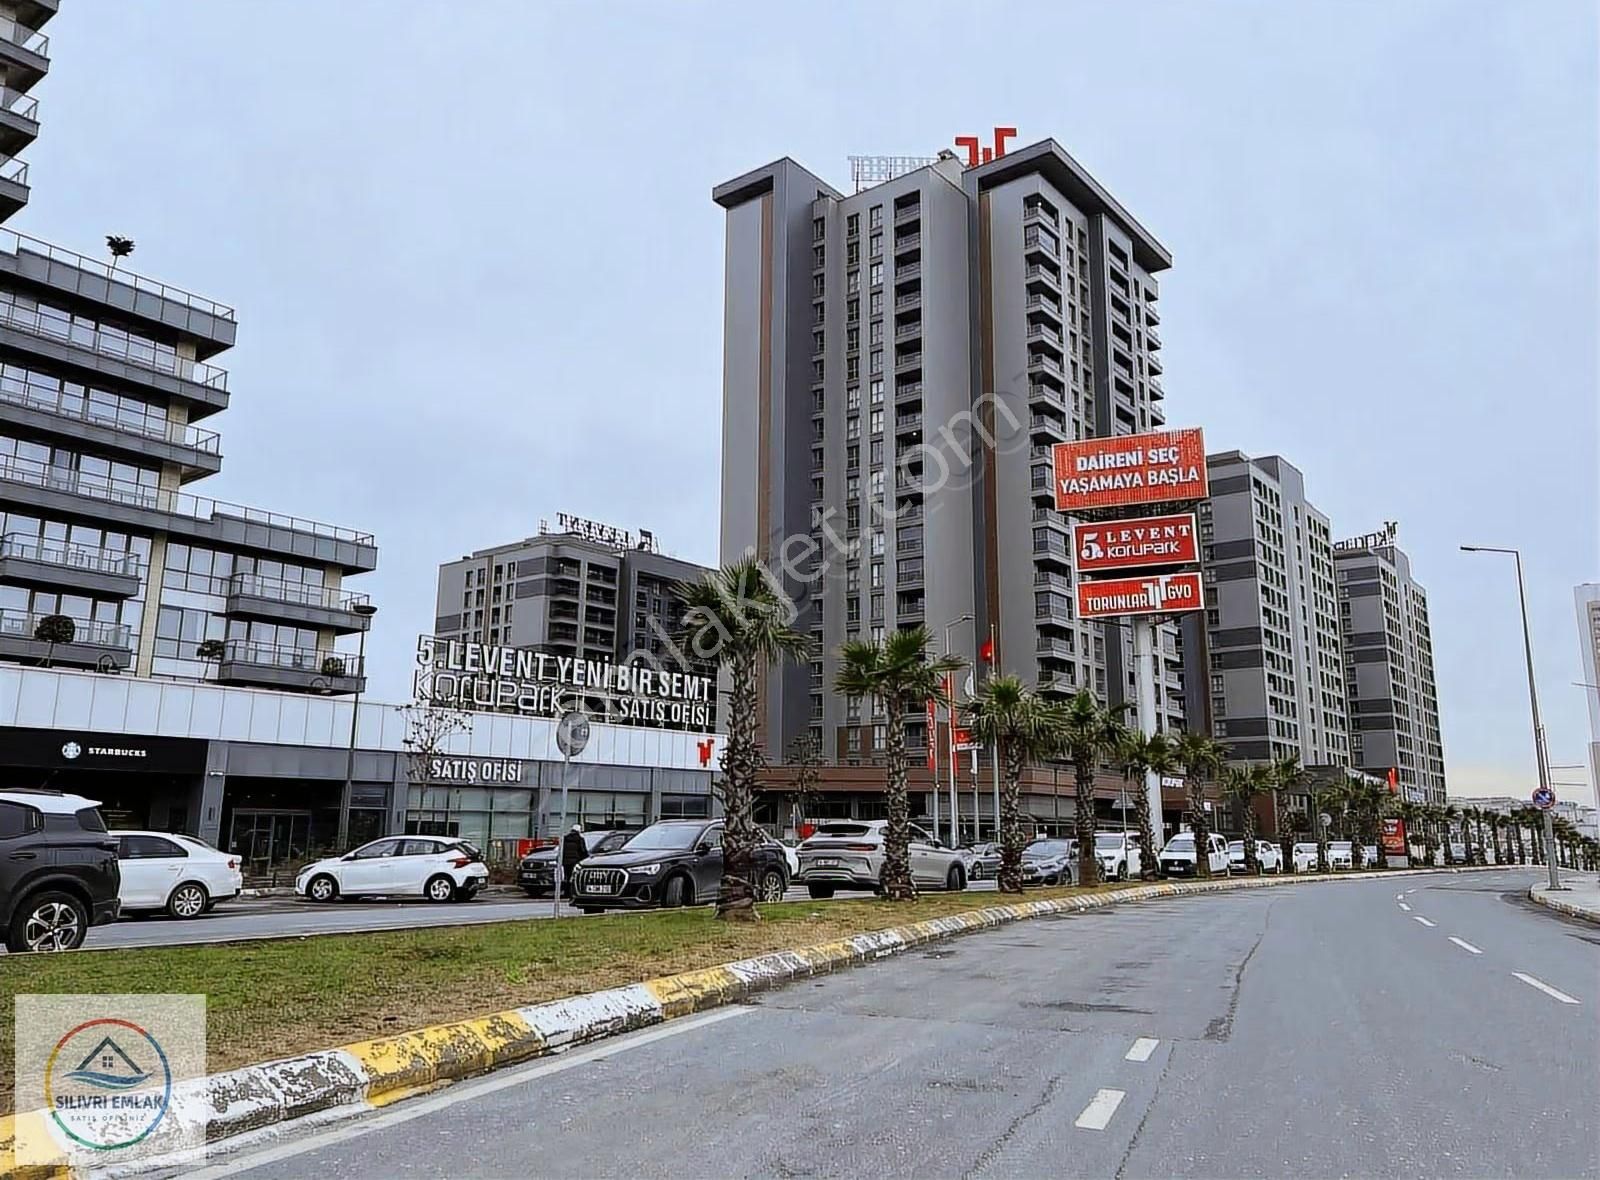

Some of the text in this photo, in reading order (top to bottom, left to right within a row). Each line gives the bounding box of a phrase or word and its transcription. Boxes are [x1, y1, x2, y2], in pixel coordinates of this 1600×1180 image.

[1076, 446, 1180, 472] DAİRENİ SEÇ
[1059, 466, 1199, 496] YAŞAMAYA BAŞLA
[1106, 524, 1191, 544] LEVENT
[1086, 584, 1192, 612] TORUNLAR GYO
[416, 634, 712, 703] 5. LEVENT YENİ BİR SEMT
[671, 702, 711, 727] OFİSİ
[88, 747, 147, 758] STARBUCKS
[431, 758, 522, 784] SATIŞ OFİSİ
